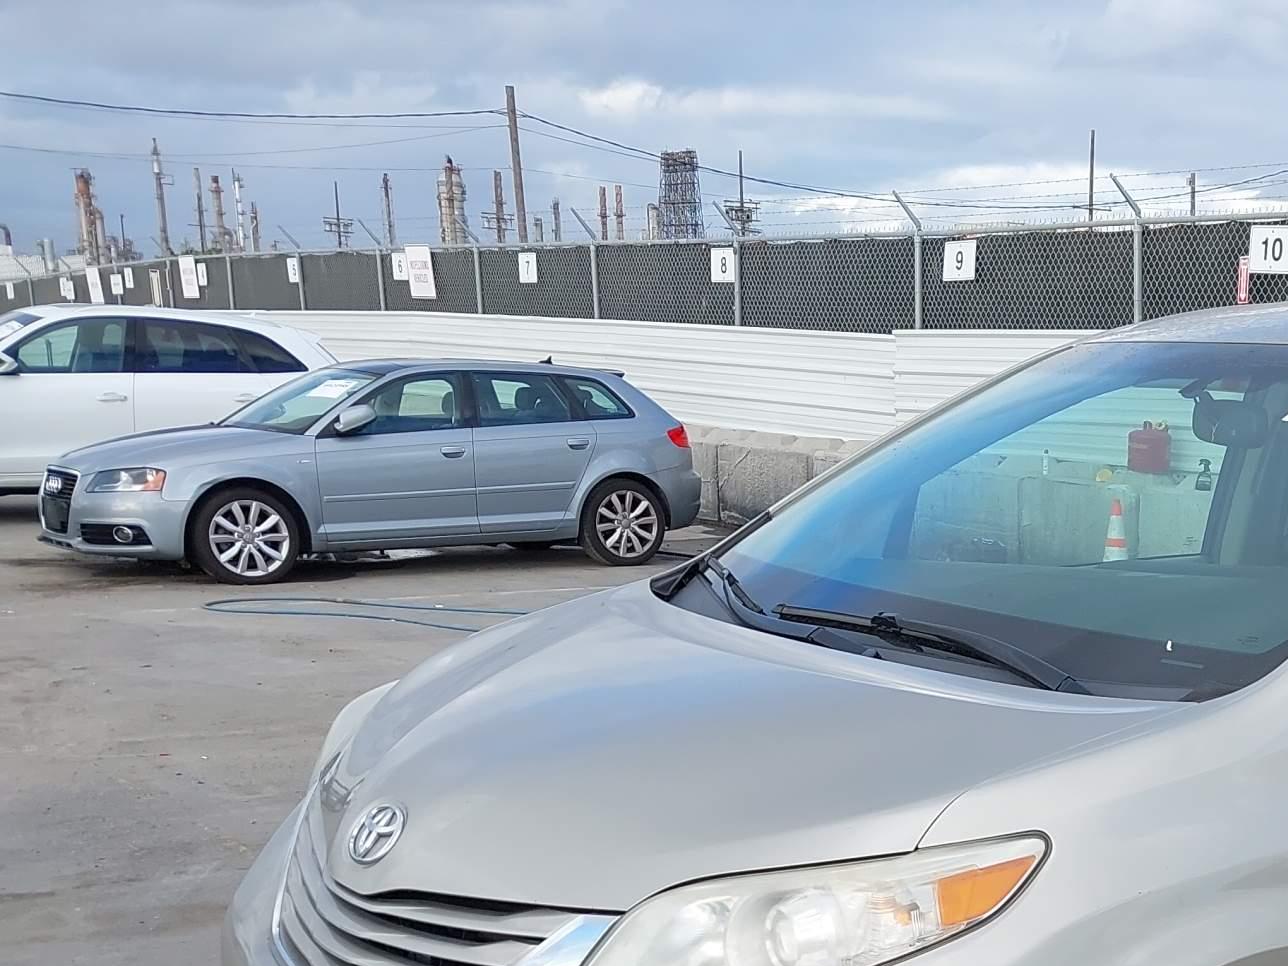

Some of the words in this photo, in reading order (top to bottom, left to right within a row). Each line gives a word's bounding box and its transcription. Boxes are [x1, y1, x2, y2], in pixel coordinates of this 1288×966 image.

[1261, 237, 1283, 262] 10
[397, 259, 403, 273] 6
[525, 260, 530, 275] 7
[720, 256, 727, 274] 8
[955, 250, 964, 271] 9
